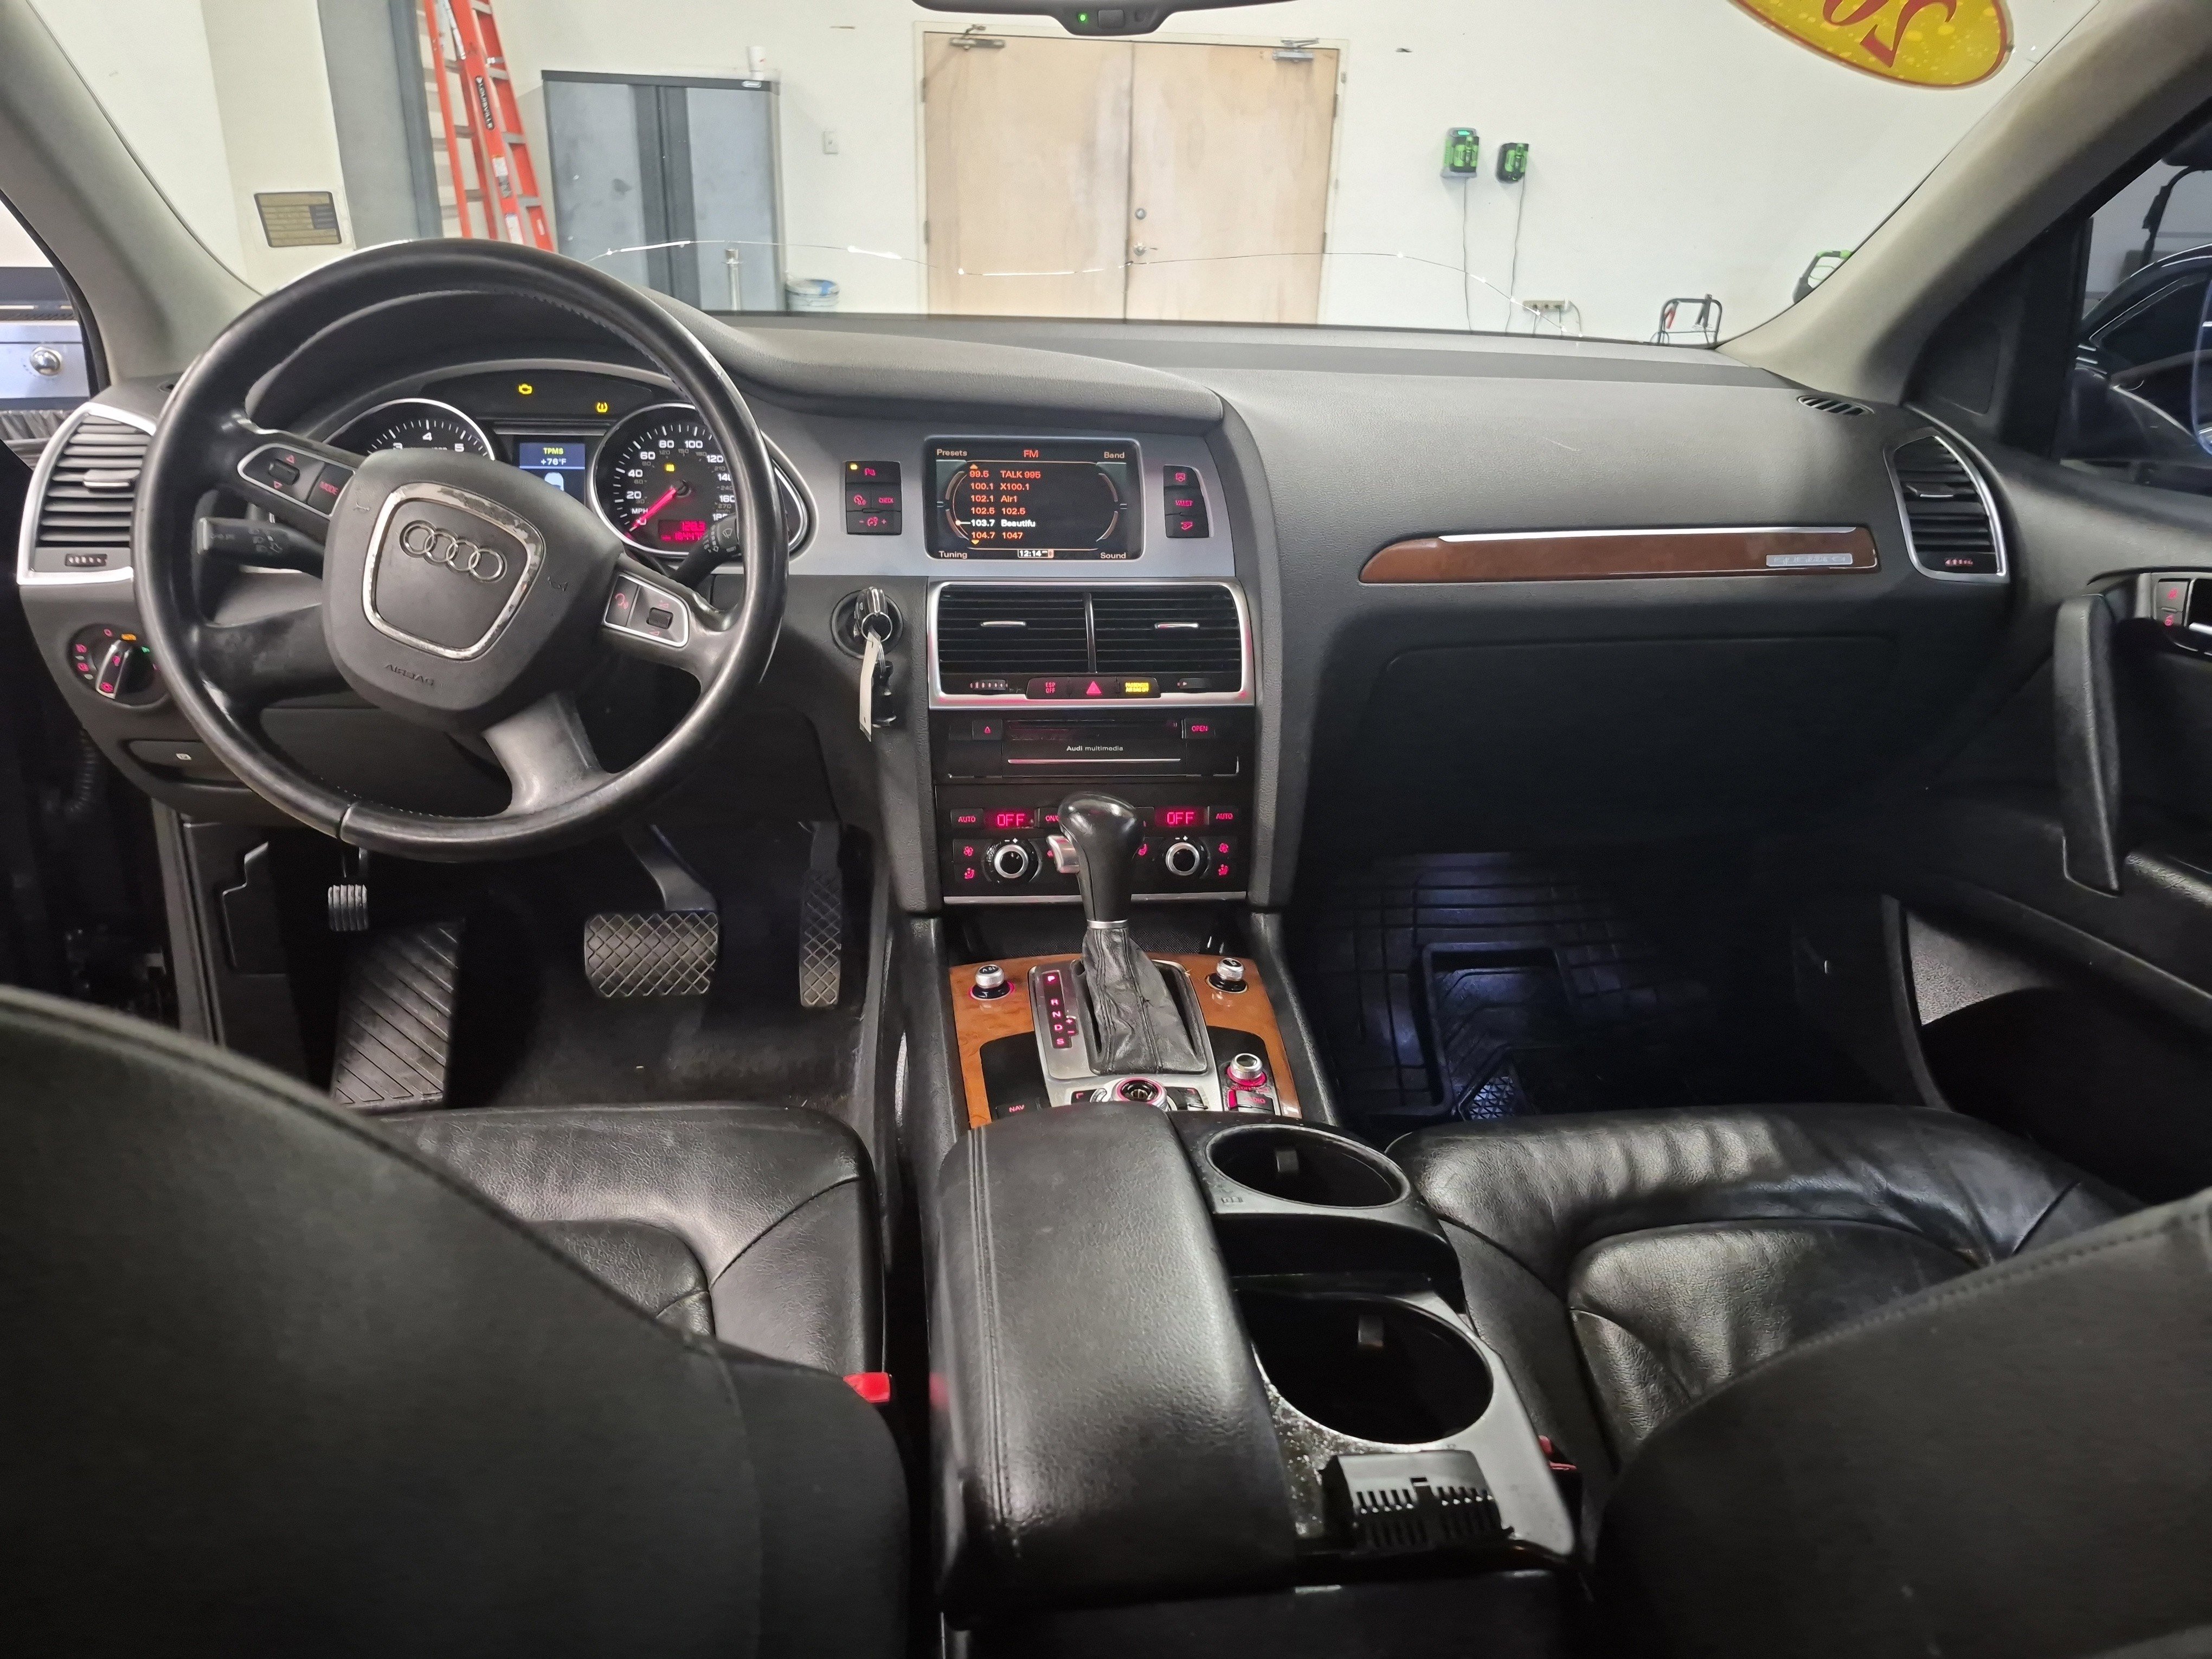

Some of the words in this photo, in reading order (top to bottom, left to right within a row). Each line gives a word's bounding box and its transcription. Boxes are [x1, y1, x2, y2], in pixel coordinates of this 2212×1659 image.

[422, 432, 433, 441] 4
[454, 443, 465, 452] 5
[659, 440, 674, 448] 80
[684, 440, 703, 448] 100
[640, 451, 655, 460] 60
[1023, 449, 1039, 458] FM
[706, 454, 724, 463] 120
[628, 469, 643, 478] 40
[969, 470, 989, 478] 99.5
[1024, 471, 1041, 479] 995
[970, 483, 994, 491] 100.1
[626, 491, 642, 499] 20
[1001, 507, 1026, 516] 102.5
[1001, 519, 1036, 528] Beautifu
[939, 551, 968, 559] Tuning
[997, 814, 1025, 827] OFF
[1167, 812, 1194, 825] OFF
